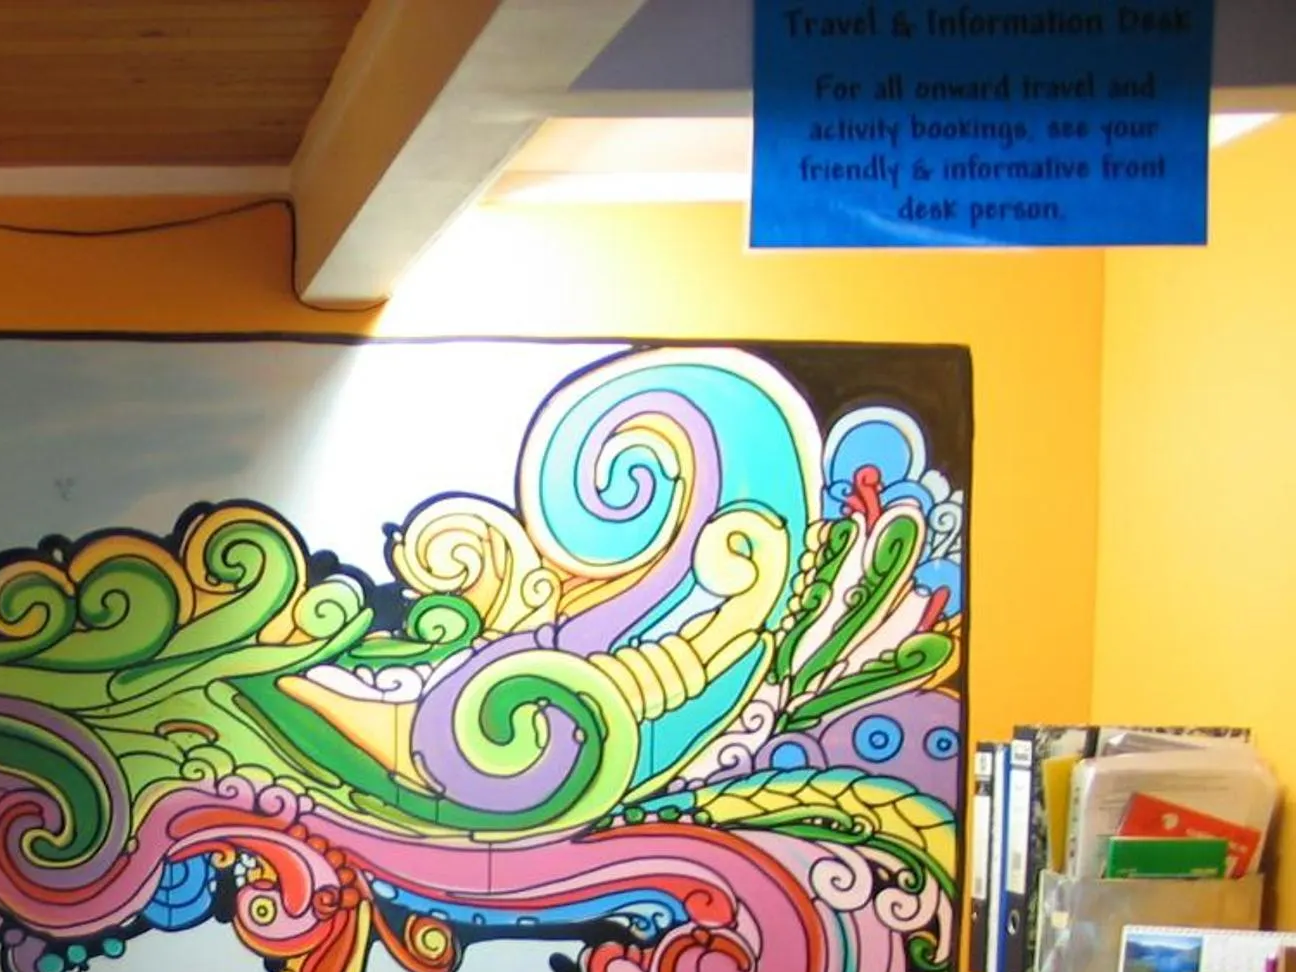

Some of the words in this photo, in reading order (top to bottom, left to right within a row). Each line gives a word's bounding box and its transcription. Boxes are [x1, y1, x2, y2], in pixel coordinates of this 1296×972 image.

[785, 6, 876, 38] Travel
[892, 11, 915, 39] &
[928, 6, 1102, 38] Information
[1117, 7, 1191, 35] Desk
[816, 73, 861, 99] For
[875, 73, 902, 99] all
[915, 74, 1009, 99] onward
[1022, 72, 1094, 98] travel
[1108, 72, 1155, 98] and
[809, 118, 899, 147] activity
[1047, 120, 1090, 139] see
[1100, 121, 1159, 145] your
[800, 154, 899, 188] friendly
[911, 157, 932, 181] &
[943, 154, 1090, 180] informative
[1101, 154, 1166, 178] front
[897, 196, 955, 221] desk
